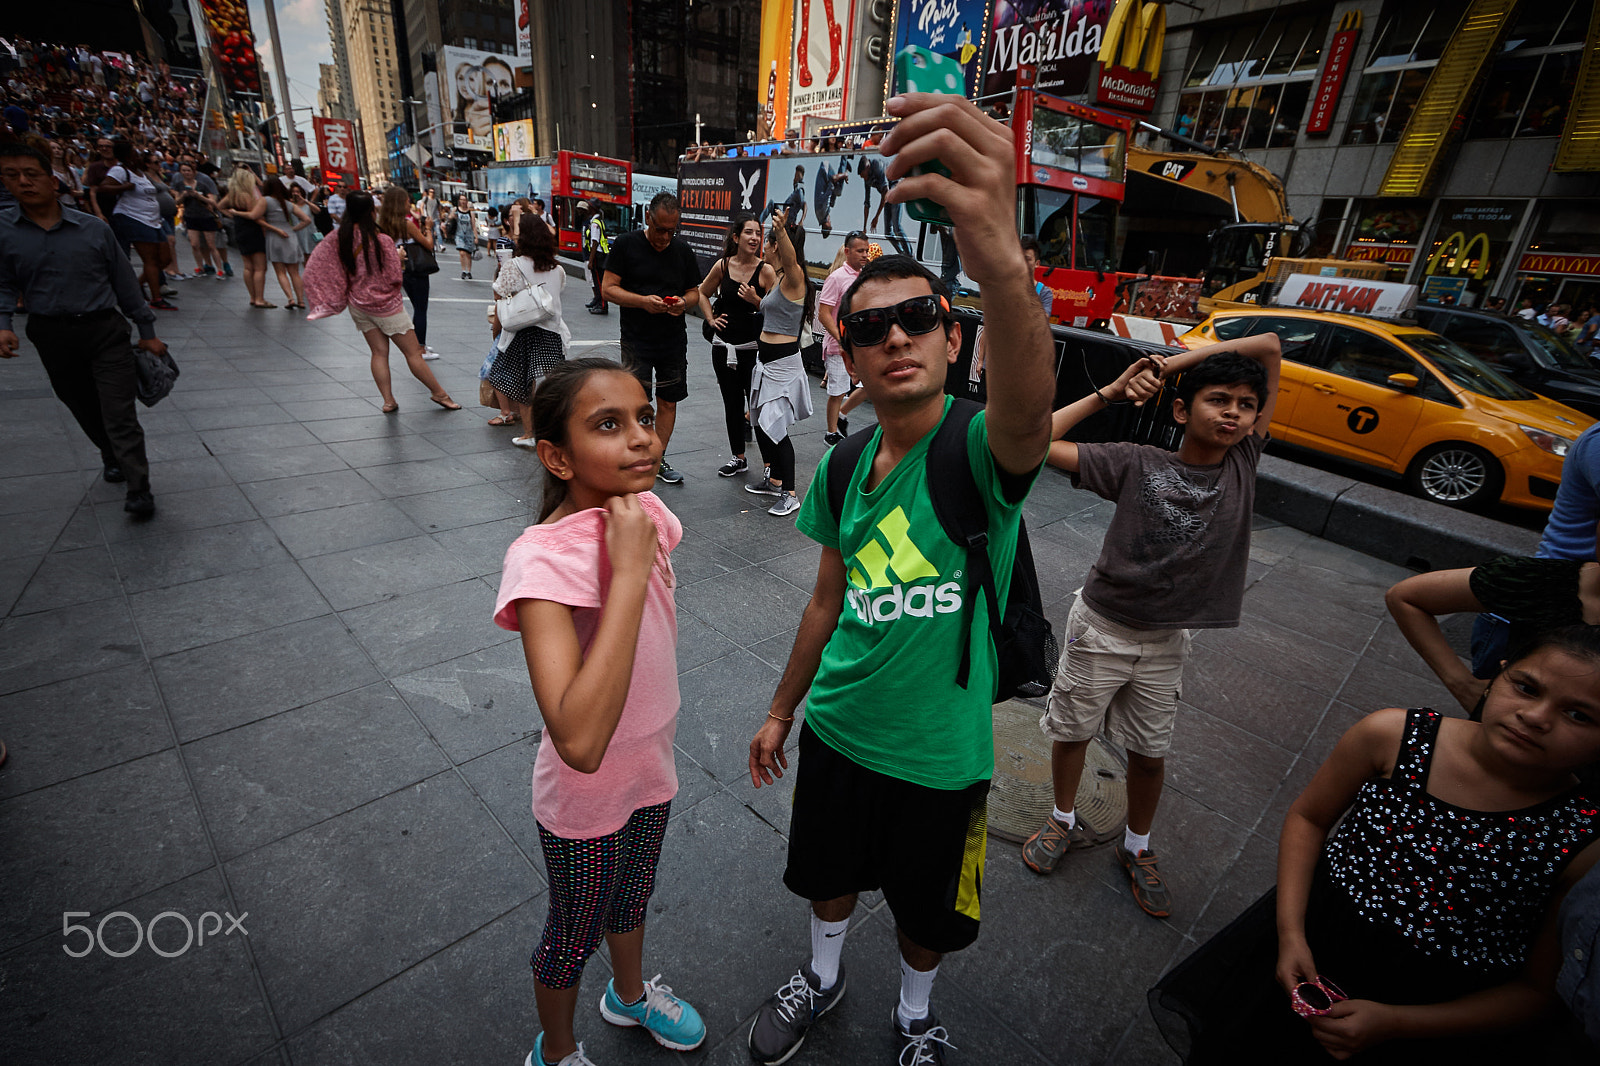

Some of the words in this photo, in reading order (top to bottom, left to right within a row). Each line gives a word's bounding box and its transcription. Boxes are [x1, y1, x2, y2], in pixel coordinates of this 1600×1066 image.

[987, 9, 1101, 74] Matilda
[1101, 76, 1156, 98] McDonald's
[1108, 92, 1144, 106] Restaurant
[323, 123, 349, 168] tkts
[1024, 120, 1033, 155] 832
[1162, 161, 1185, 180] CAT
[680, 189, 732, 211] FLEX/DENIM
[1243, 293, 1258, 303] CA
[1296, 282, 1384, 314] ANT-MAN
[847, 581, 962, 626] adidas
